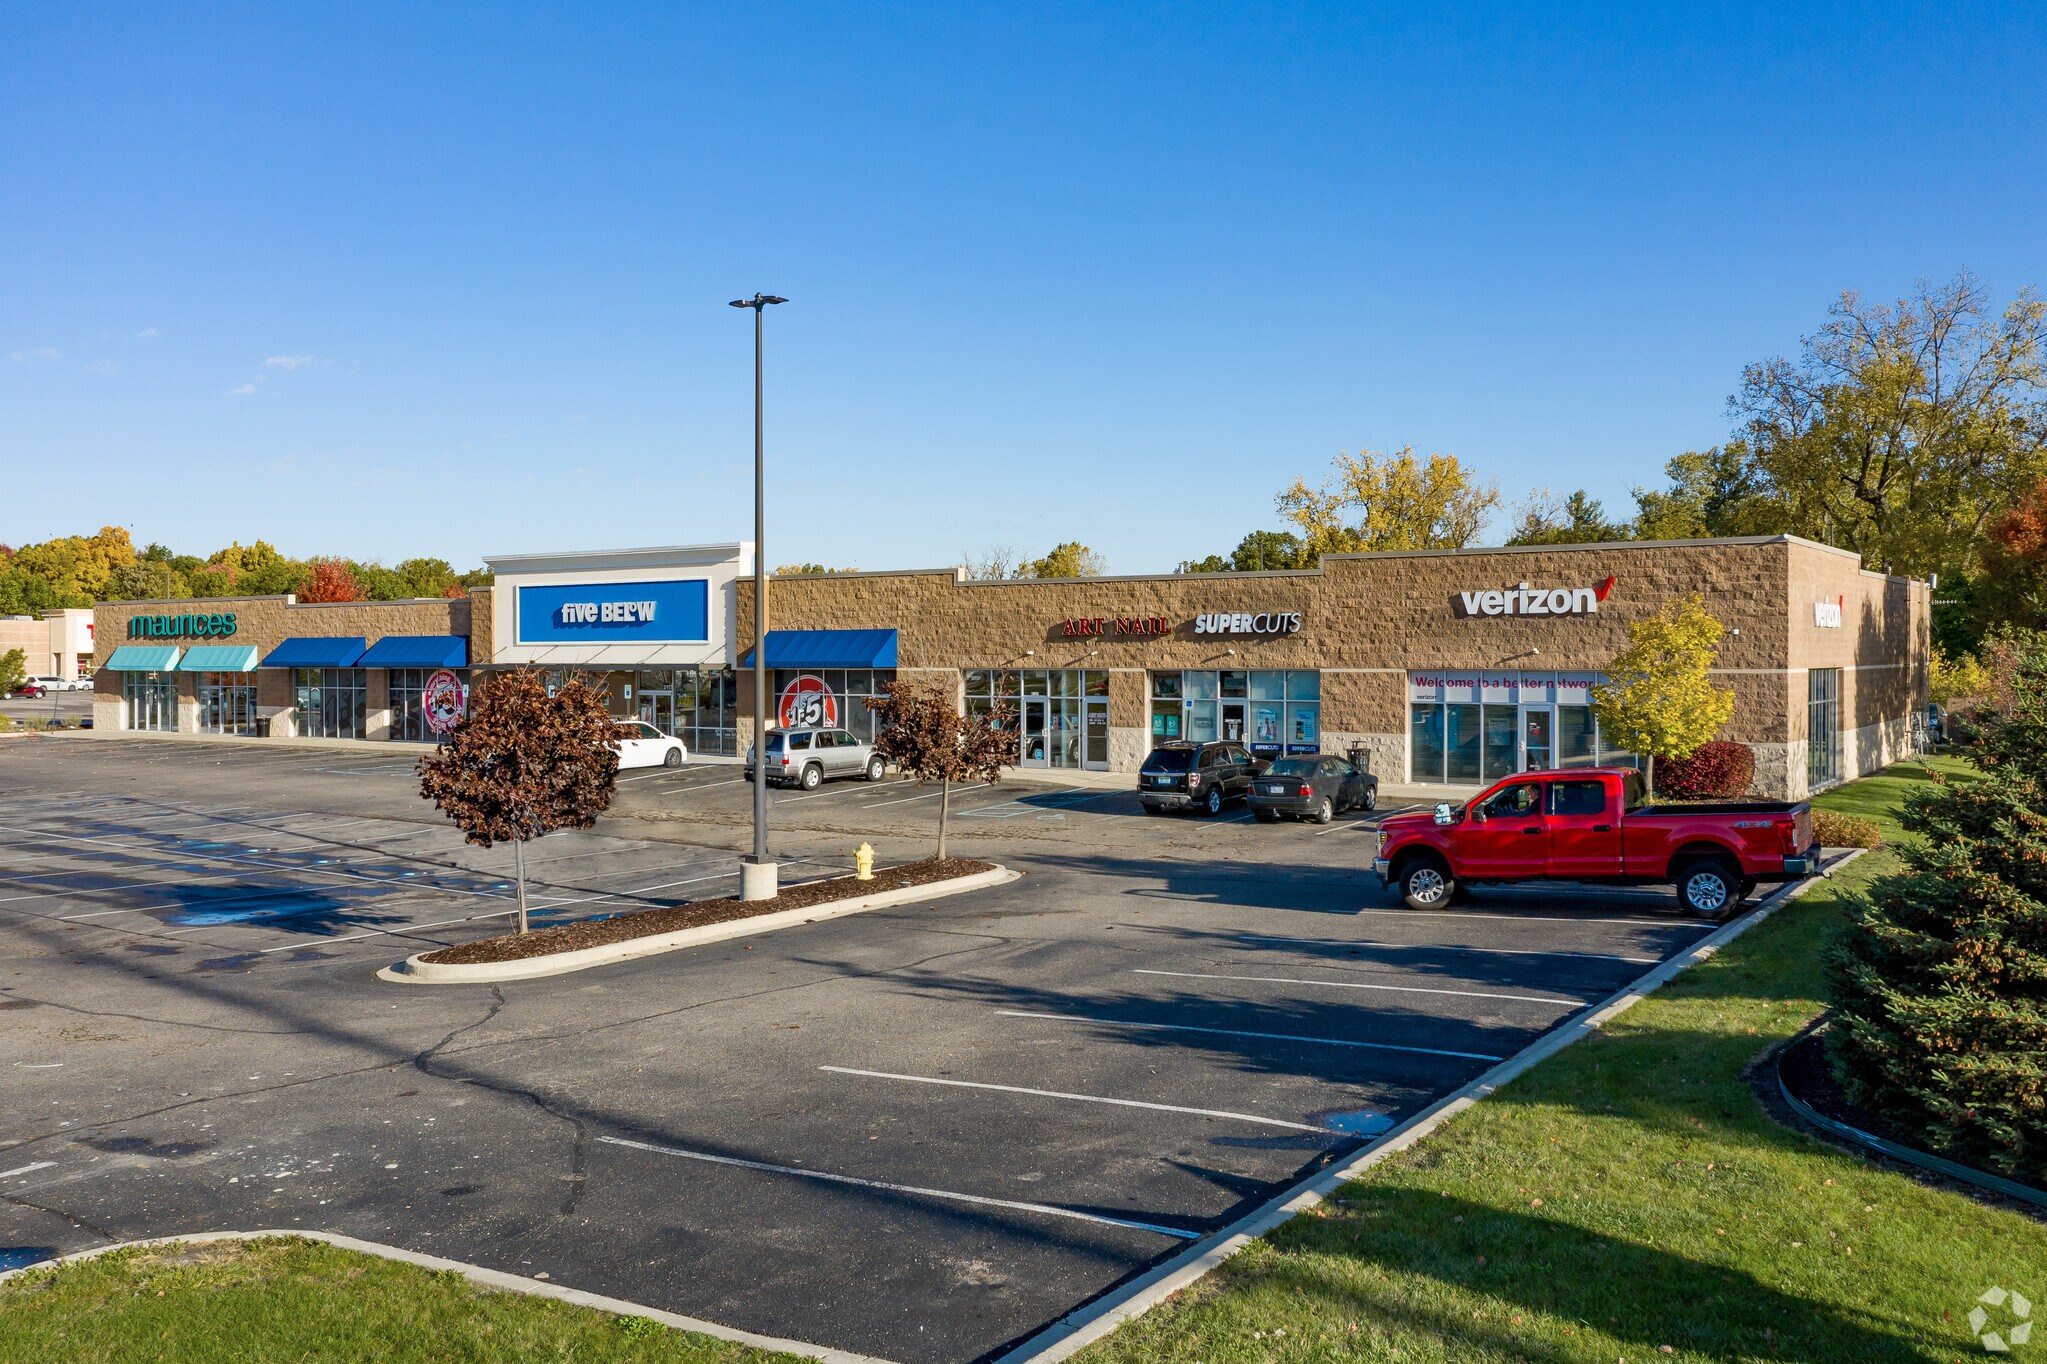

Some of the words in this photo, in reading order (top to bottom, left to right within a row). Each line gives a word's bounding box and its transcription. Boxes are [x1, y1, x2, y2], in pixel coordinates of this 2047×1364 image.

[1460, 582, 1596, 615] verizon
[561, 602, 598, 623] five
[1195, 612, 1302, 634] SUPERCUTS
[1814, 596, 1841, 628] verizon
[131, 613, 236, 636] maurices
[1062, 617, 1104, 636] ART
[1115, 617, 1172, 635] NAIL
[1415, 676, 1474, 688] Welcome
[1477, 677, 1489, 688] to
[1492, 679, 1499, 688] a
[1503, 677, 1543, 689] better
[1546, 678, 1595, 689] networ
